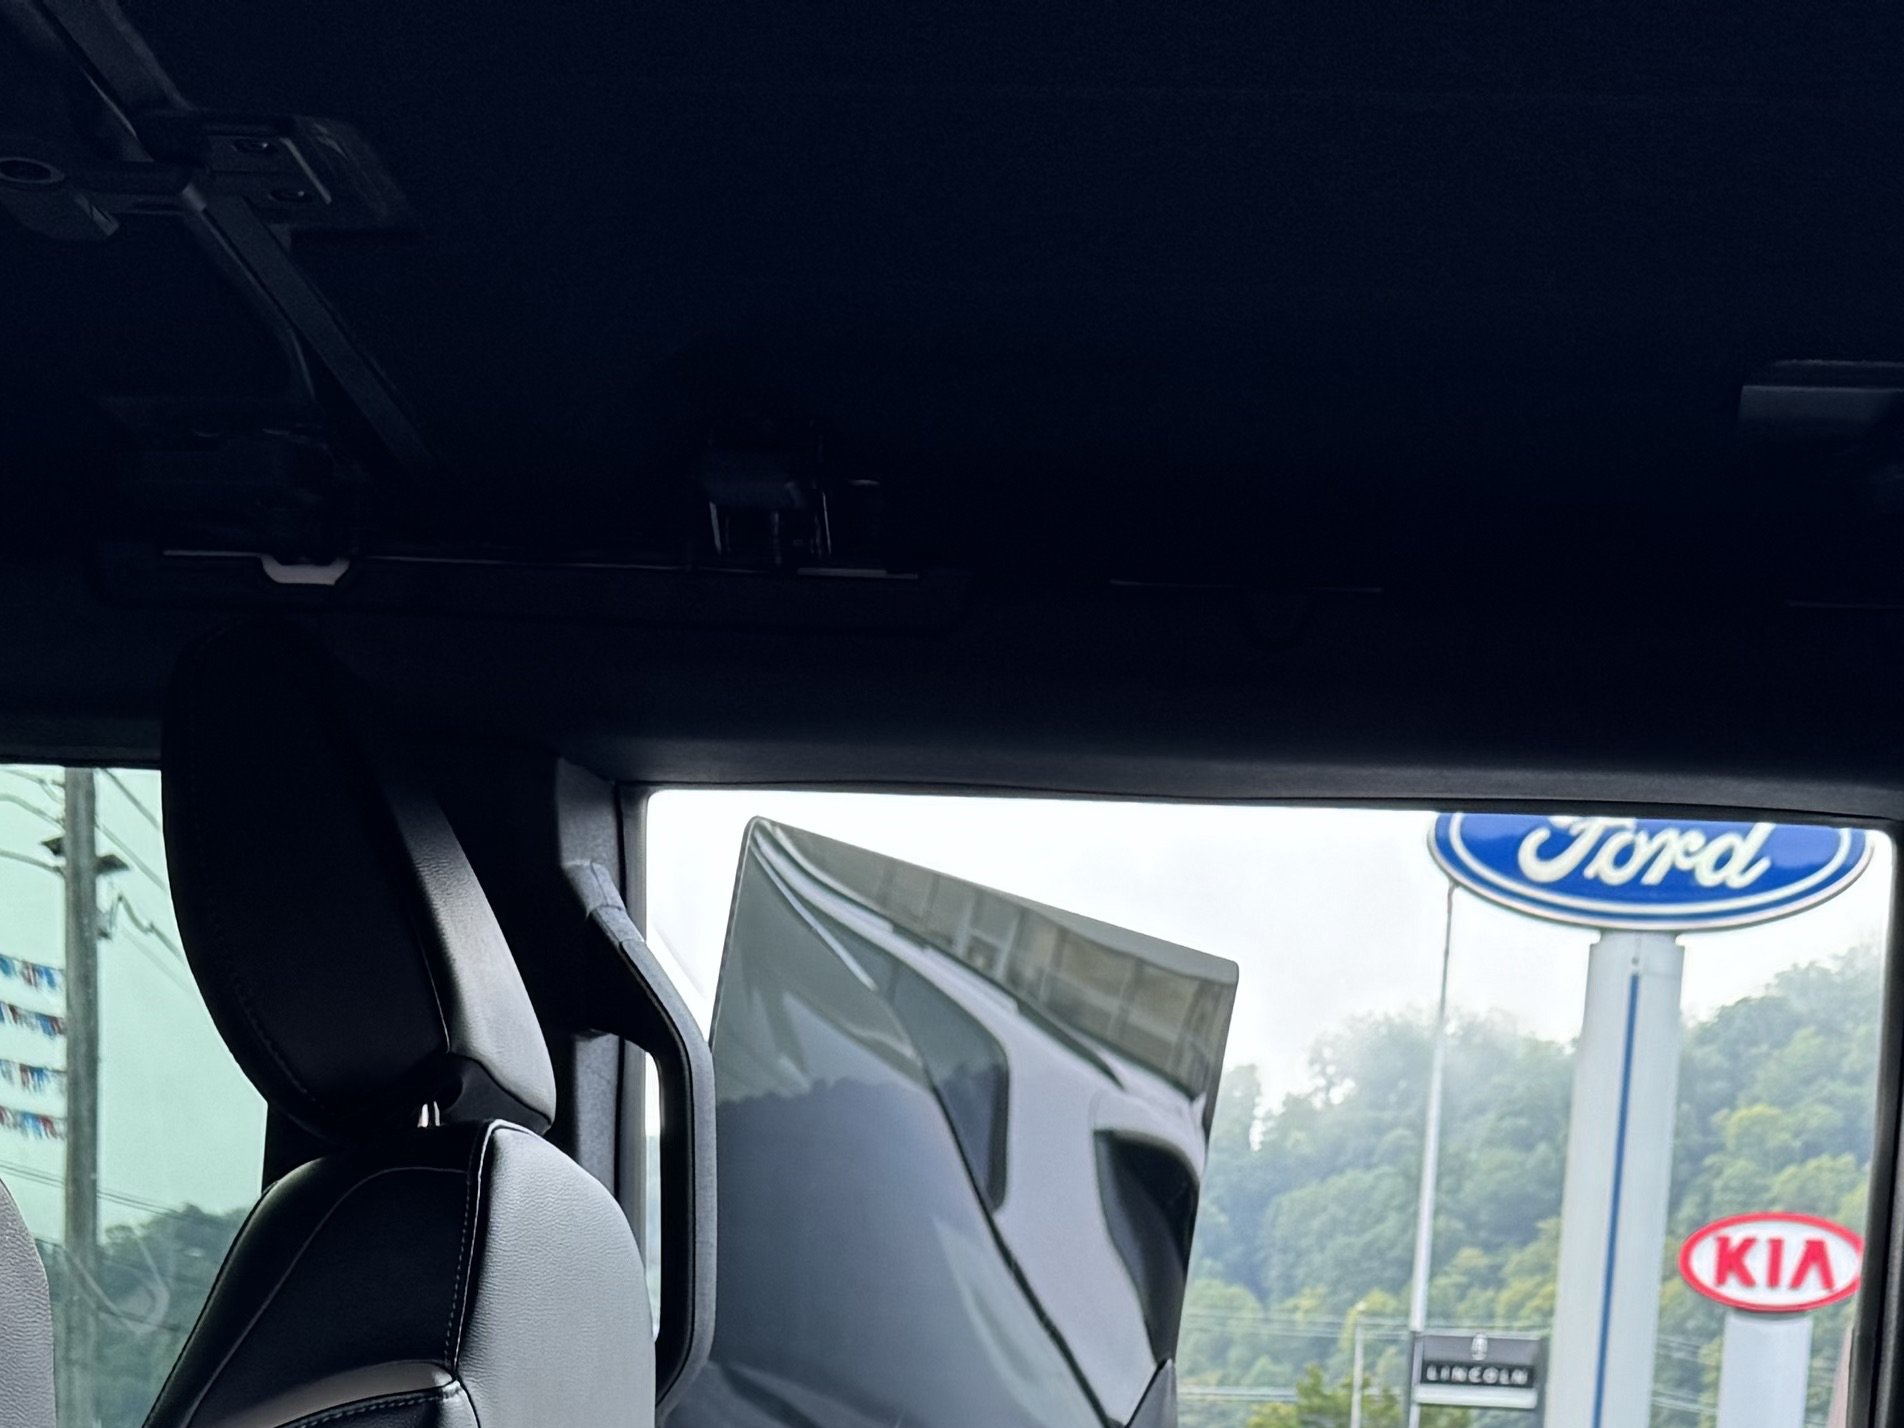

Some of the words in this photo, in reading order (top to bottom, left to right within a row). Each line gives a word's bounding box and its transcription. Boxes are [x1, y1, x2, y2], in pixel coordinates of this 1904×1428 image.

[1518, 816, 1776, 888] Ford
[1714, 1235, 1835, 1291] KIA
[1426, 1364, 1528, 1385] LINCOLN
